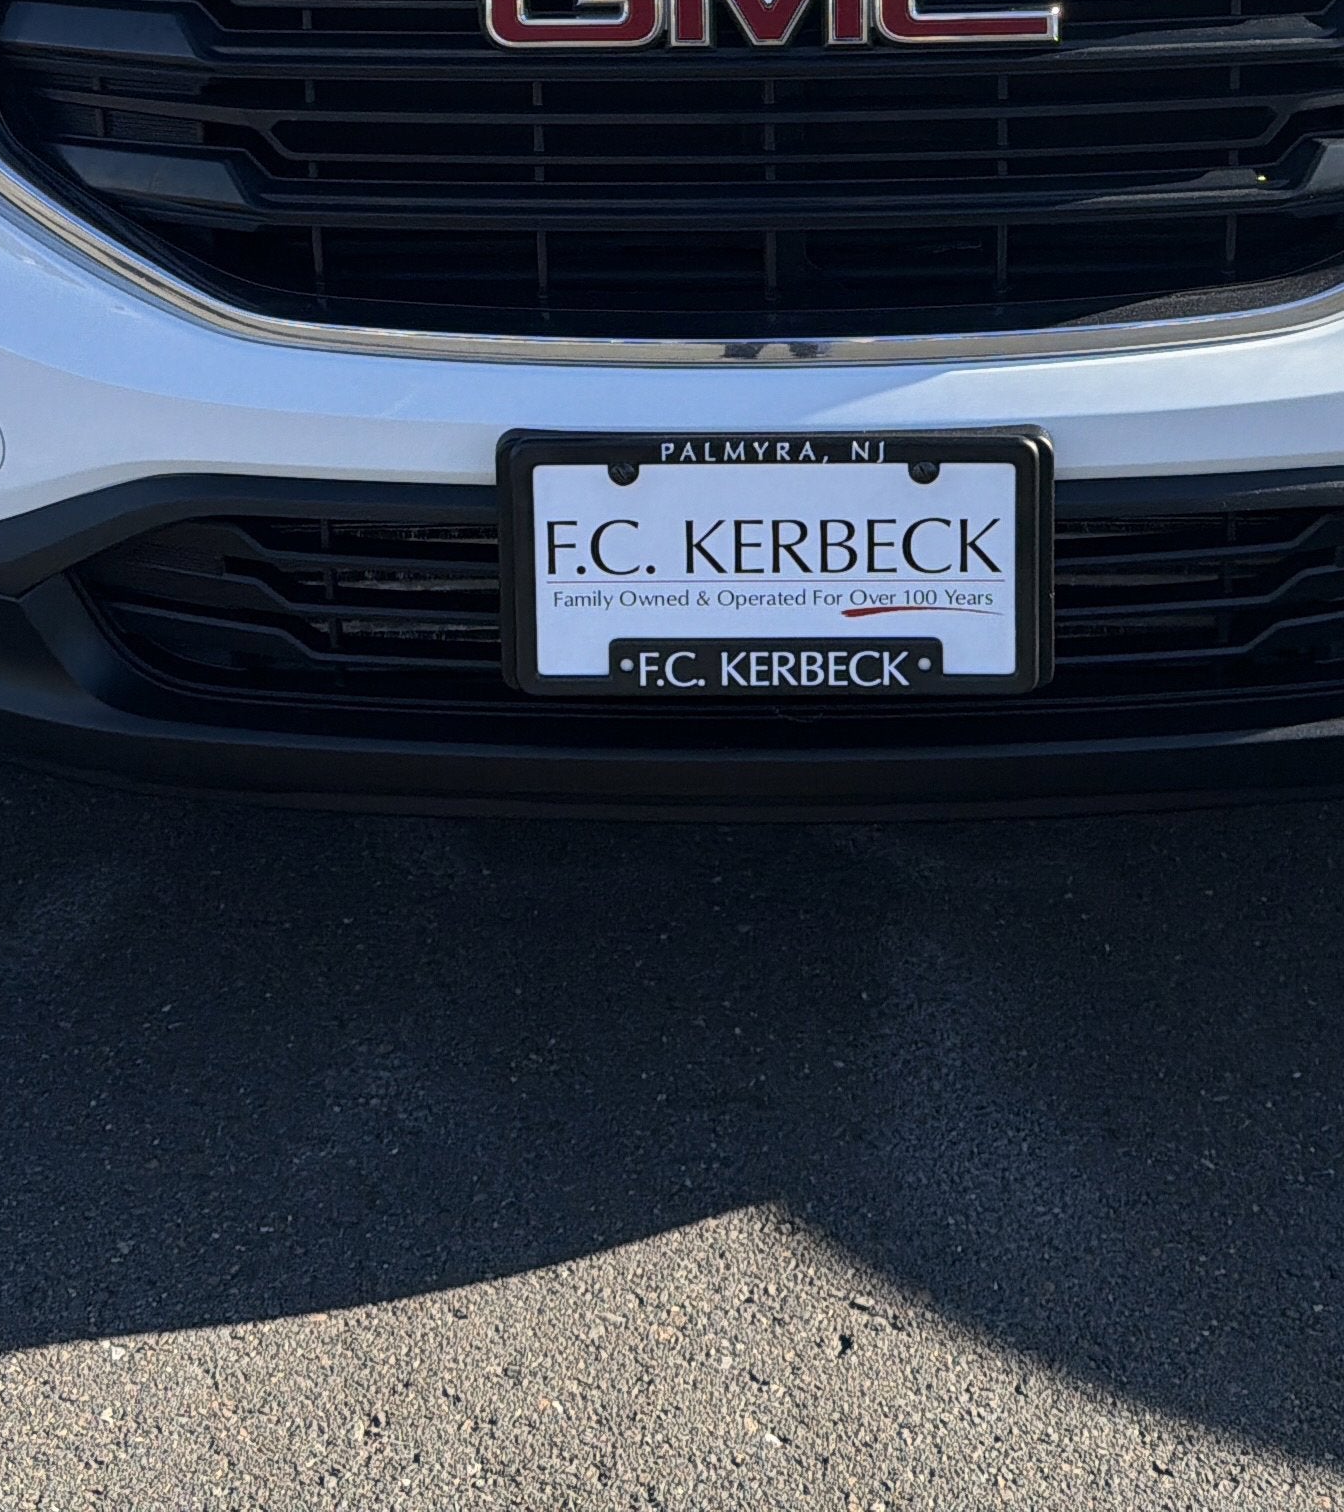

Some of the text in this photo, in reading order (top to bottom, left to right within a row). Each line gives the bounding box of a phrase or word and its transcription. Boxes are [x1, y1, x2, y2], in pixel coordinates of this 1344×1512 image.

[660, 441, 887, 463] PALMYRA, NJ
[545, 517, 1003, 576] F.C. KERBECK
[553, 589, 994, 610] Family Owned & Operated For Over 100 Years
[637, 650, 910, 688] F.C. KERBECK
